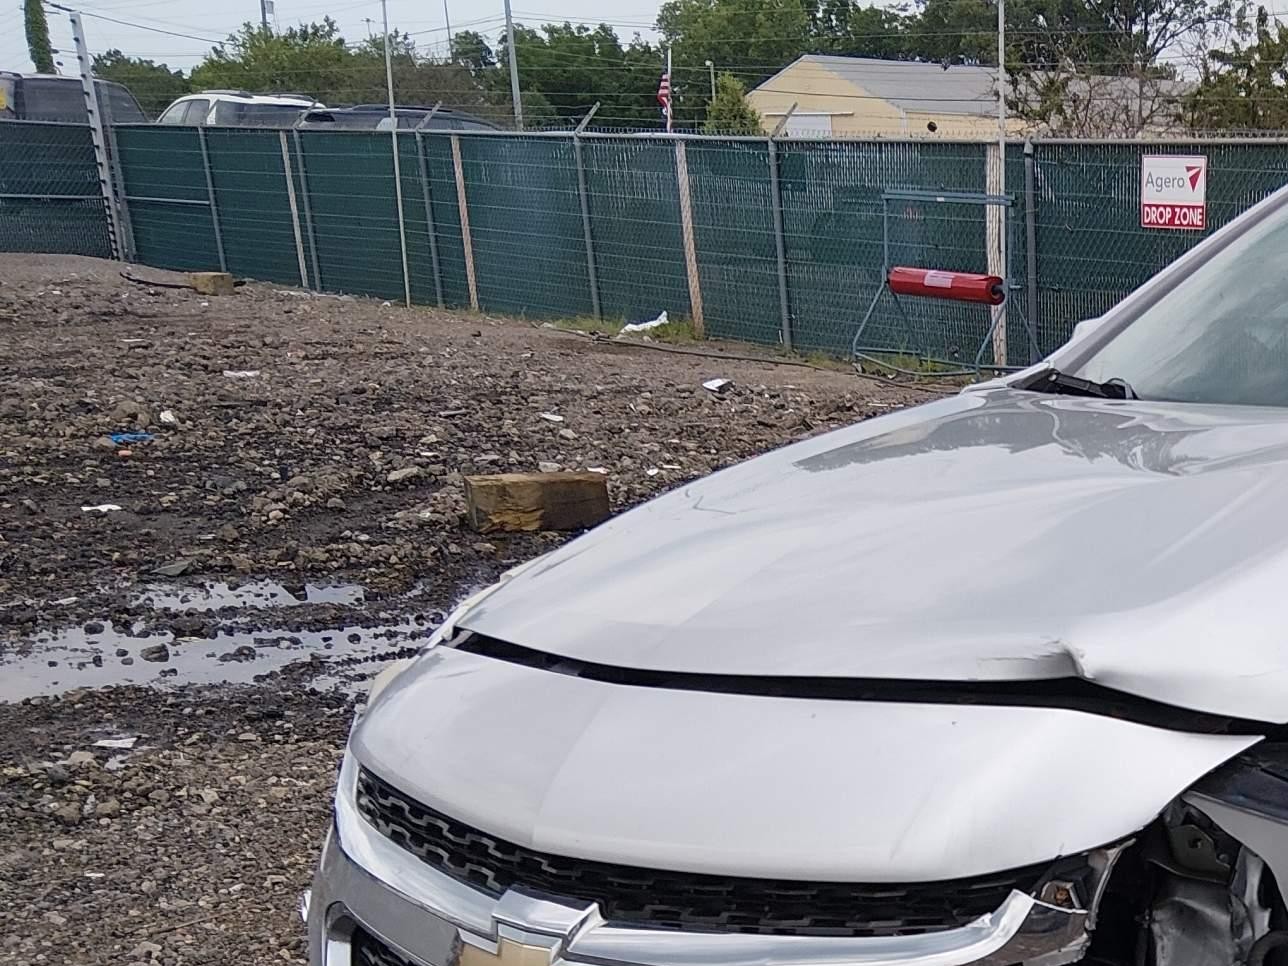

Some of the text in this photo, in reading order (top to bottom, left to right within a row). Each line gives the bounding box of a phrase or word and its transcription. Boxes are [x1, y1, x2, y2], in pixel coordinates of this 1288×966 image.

[1145, 171, 1185, 193] Agero
[1144, 206, 1203, 226] DROP ZONE
